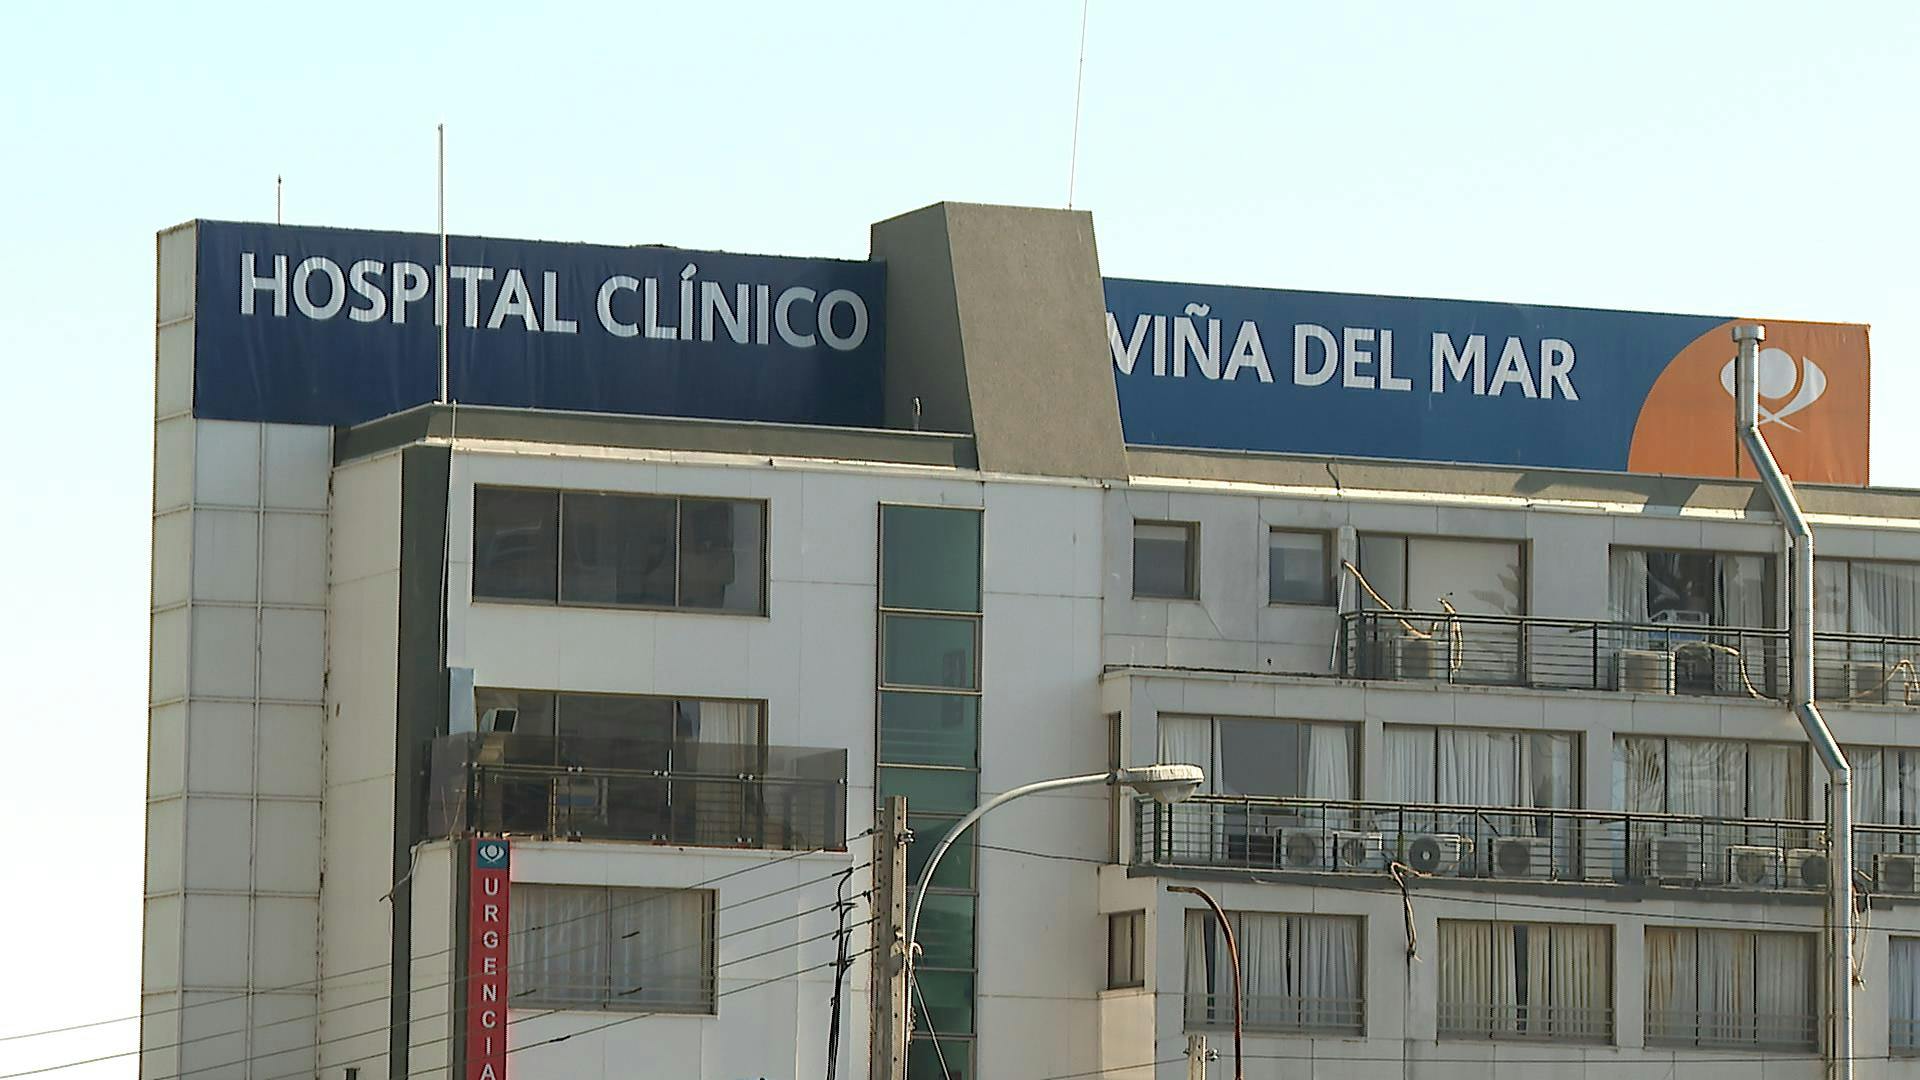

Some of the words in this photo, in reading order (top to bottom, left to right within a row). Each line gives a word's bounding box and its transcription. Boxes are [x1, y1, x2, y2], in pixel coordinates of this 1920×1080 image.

[240, 252, 578, 333] HOSPITAL
[598, 264, 869, 351] CLÍNICO
[1106, 302, 1273, 383] VIÑA
[1294, 324, 1412, 391] DEL
[1432, 333, 1580, 400] MAR
[480, 877, 499, 1080] URGENCIA
